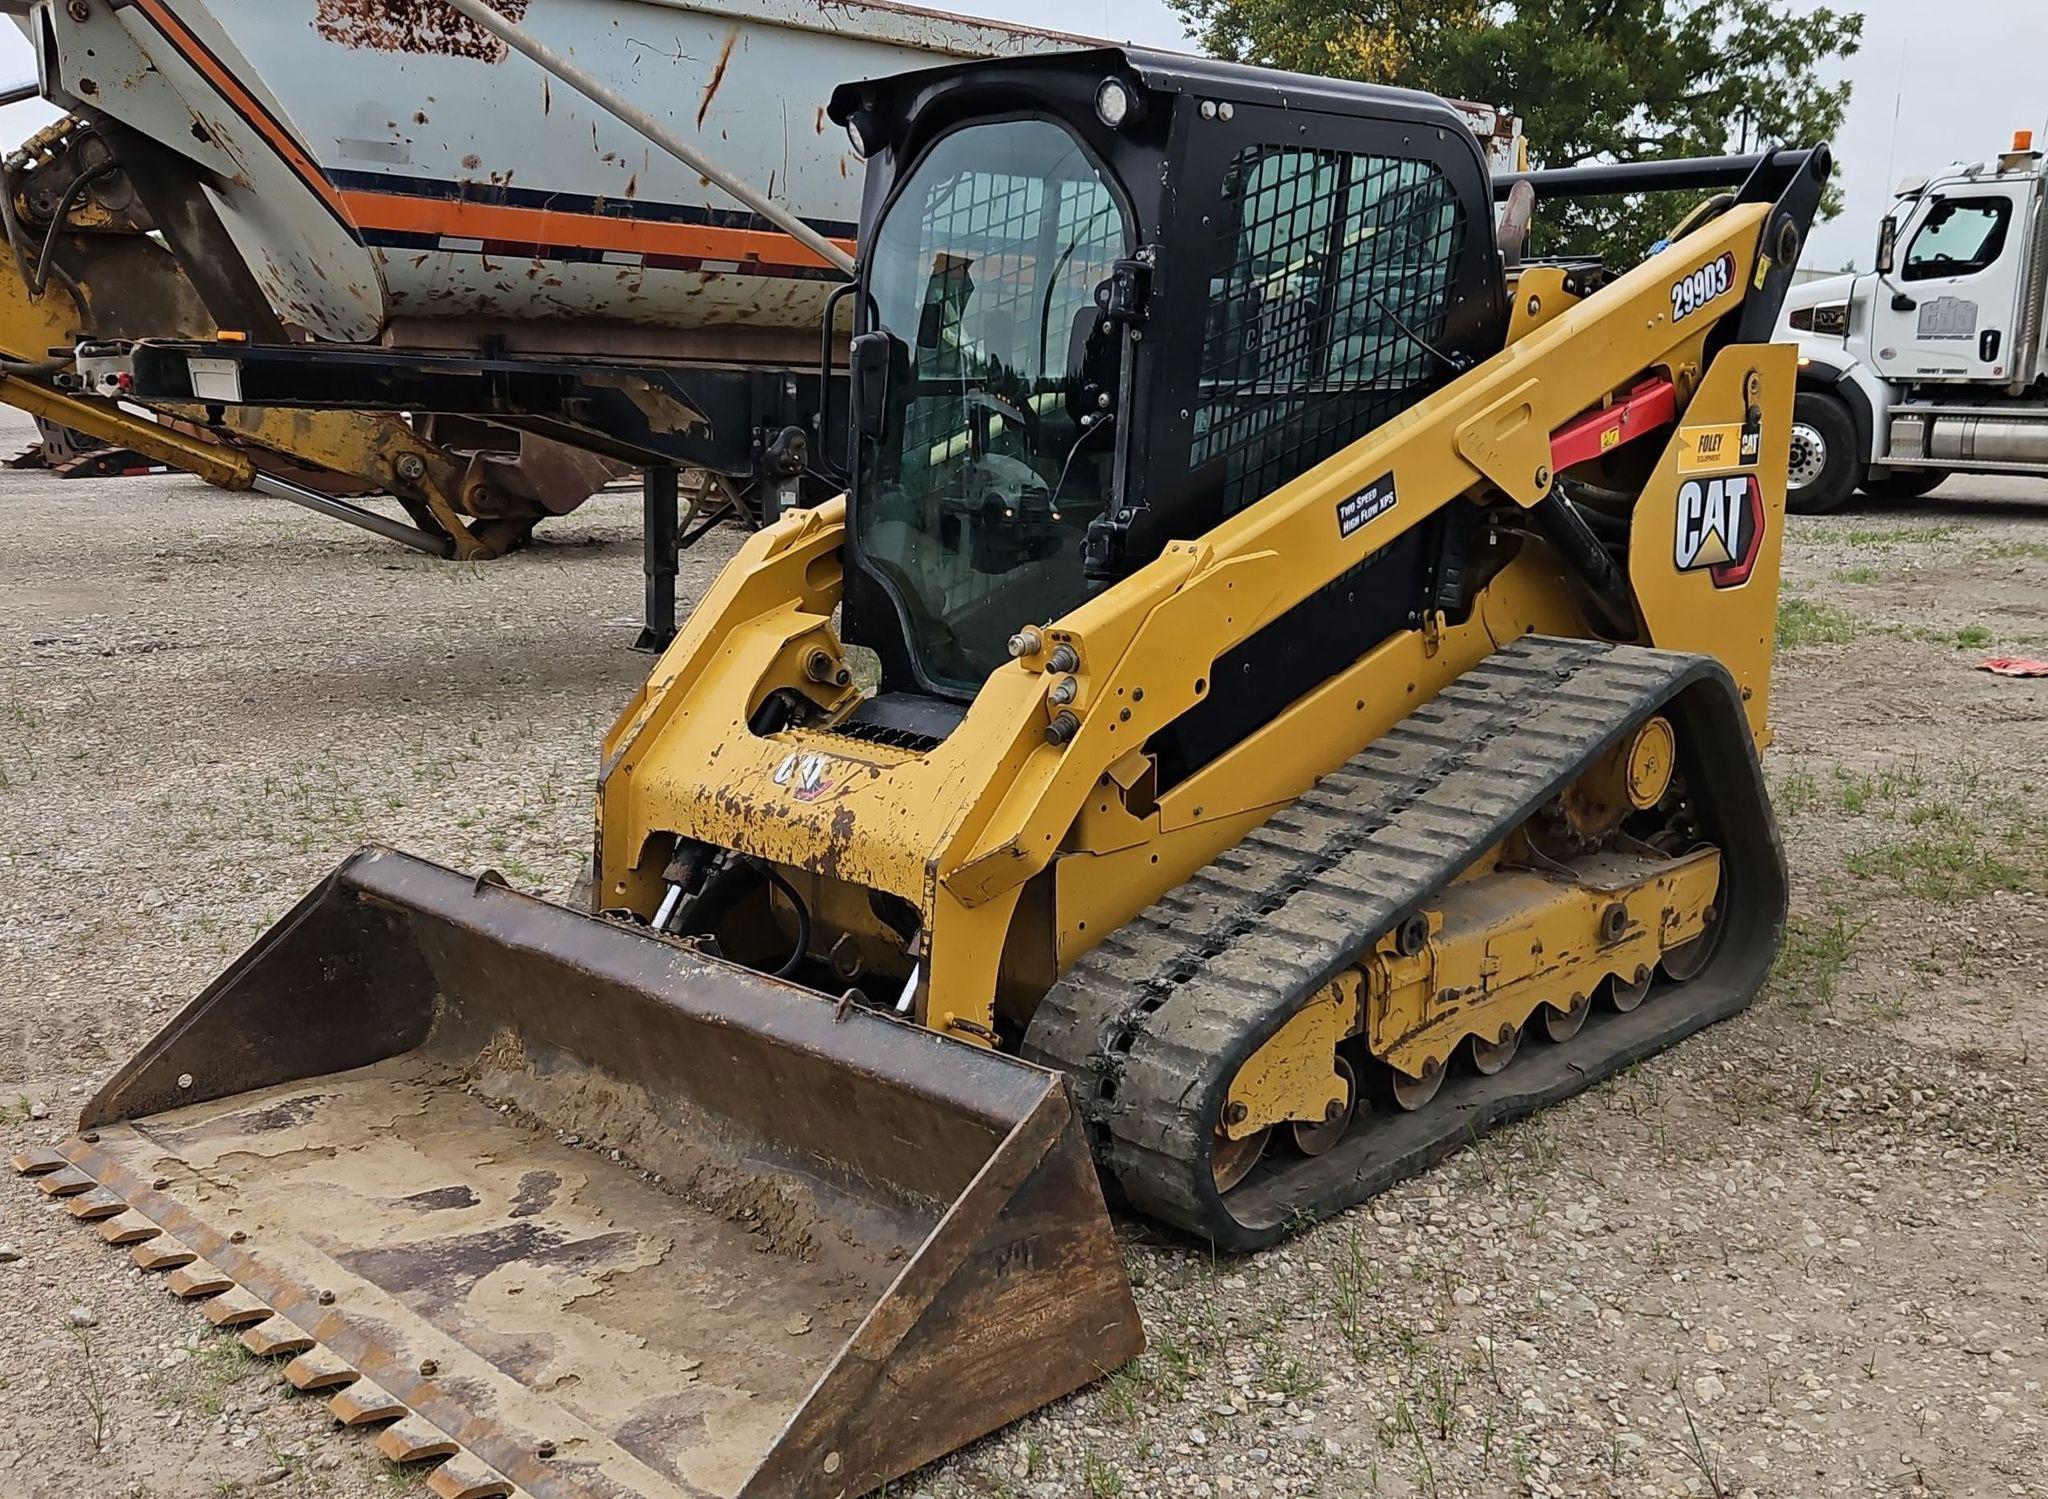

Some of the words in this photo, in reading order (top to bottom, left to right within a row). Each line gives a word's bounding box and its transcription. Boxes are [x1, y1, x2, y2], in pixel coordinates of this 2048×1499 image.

[1671, 256, 1727, 321] 299D3
[1697, 432, 1725, 454] FOLEY
[1741, 433, 1759, 455] CAT
[1379, 490, 1394, 511] XPS
[1675, 476, 1748, 569] CAT
